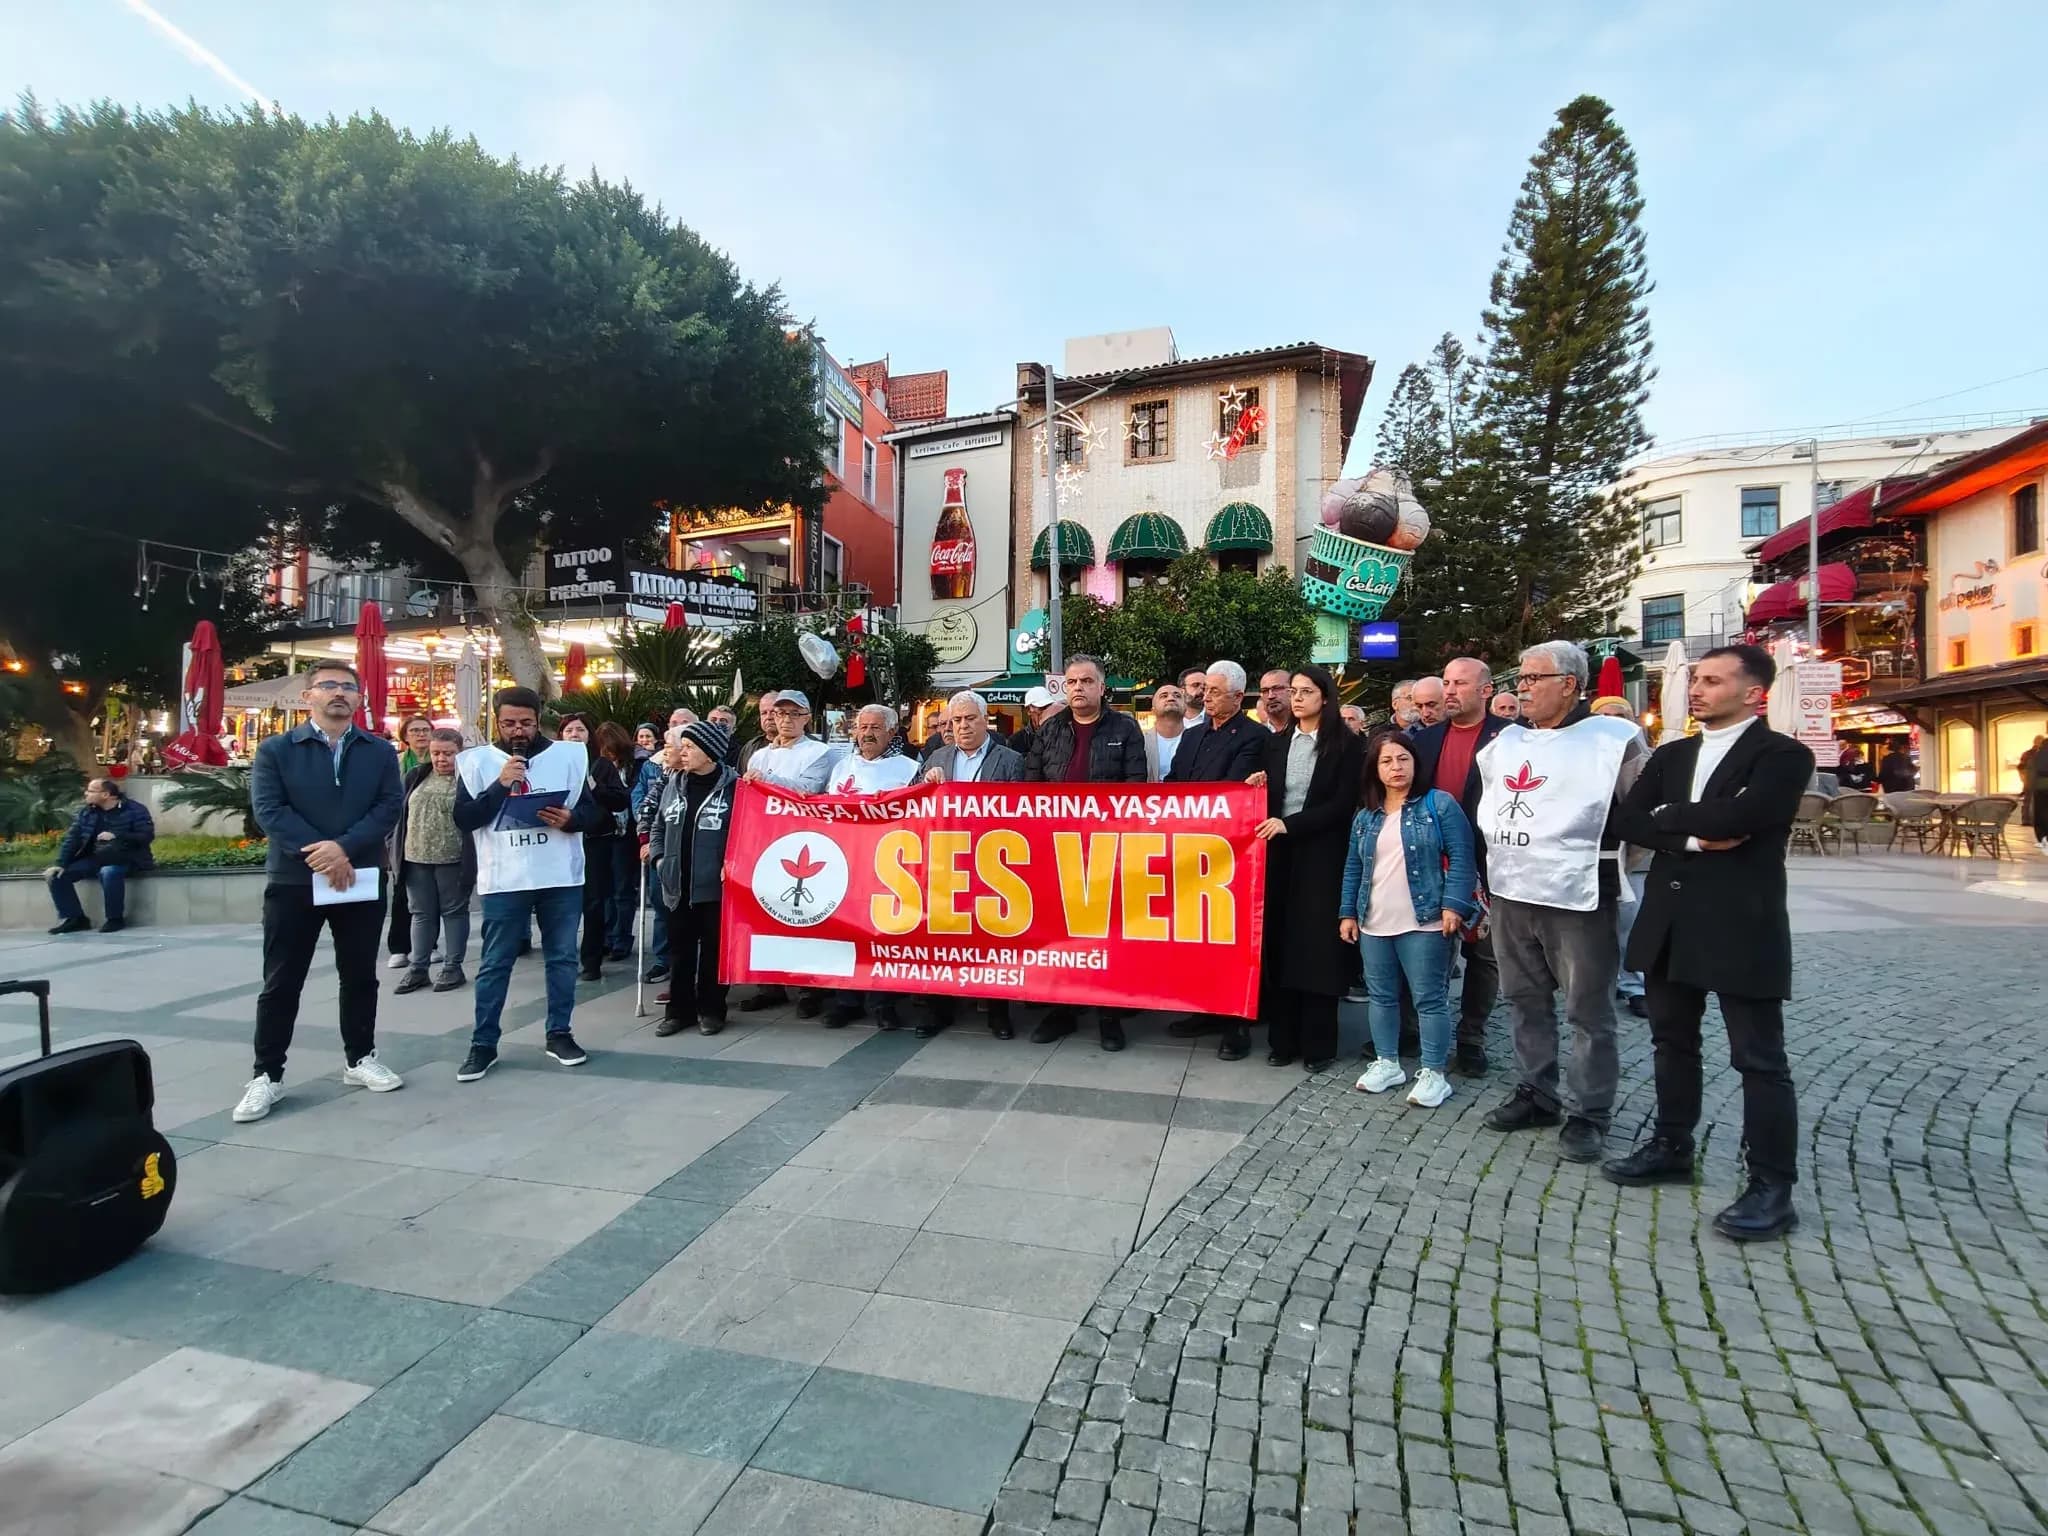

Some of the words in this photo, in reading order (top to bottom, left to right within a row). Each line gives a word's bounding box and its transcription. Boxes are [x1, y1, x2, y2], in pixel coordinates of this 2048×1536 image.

[553, 547, 612, 568] TATTOO
[930, 542, 973, 566] Coca-Cola
[576, 568, 588, 581] &
[550, 580, 616, 601] PIERCING
[630, 571, 687, 601] TATTOO
[688, 581, 701, 603] &
[765, 796, 858, 823] BARIŞA,
[859, 799, 936, 820] İNSAN
[943, 795, 1109, 822] HAKLARINA,
[1109, 795, 1232, 825] YAŞAMA
[870, 829, 1033, 938] SES
[1053, 832, 1236, 945] VER
[778, 912, 809, 925] HAKLARI
[870, 941, 929, 961] İNSAN
[934, 947, 1018, 965] HAKLARI
[1022, 950, 1108, 970] DERNEĞİ
[870, 963, 953, 982] ANTALYA
[958, 966, 1025, 986] ŞUBESİ
